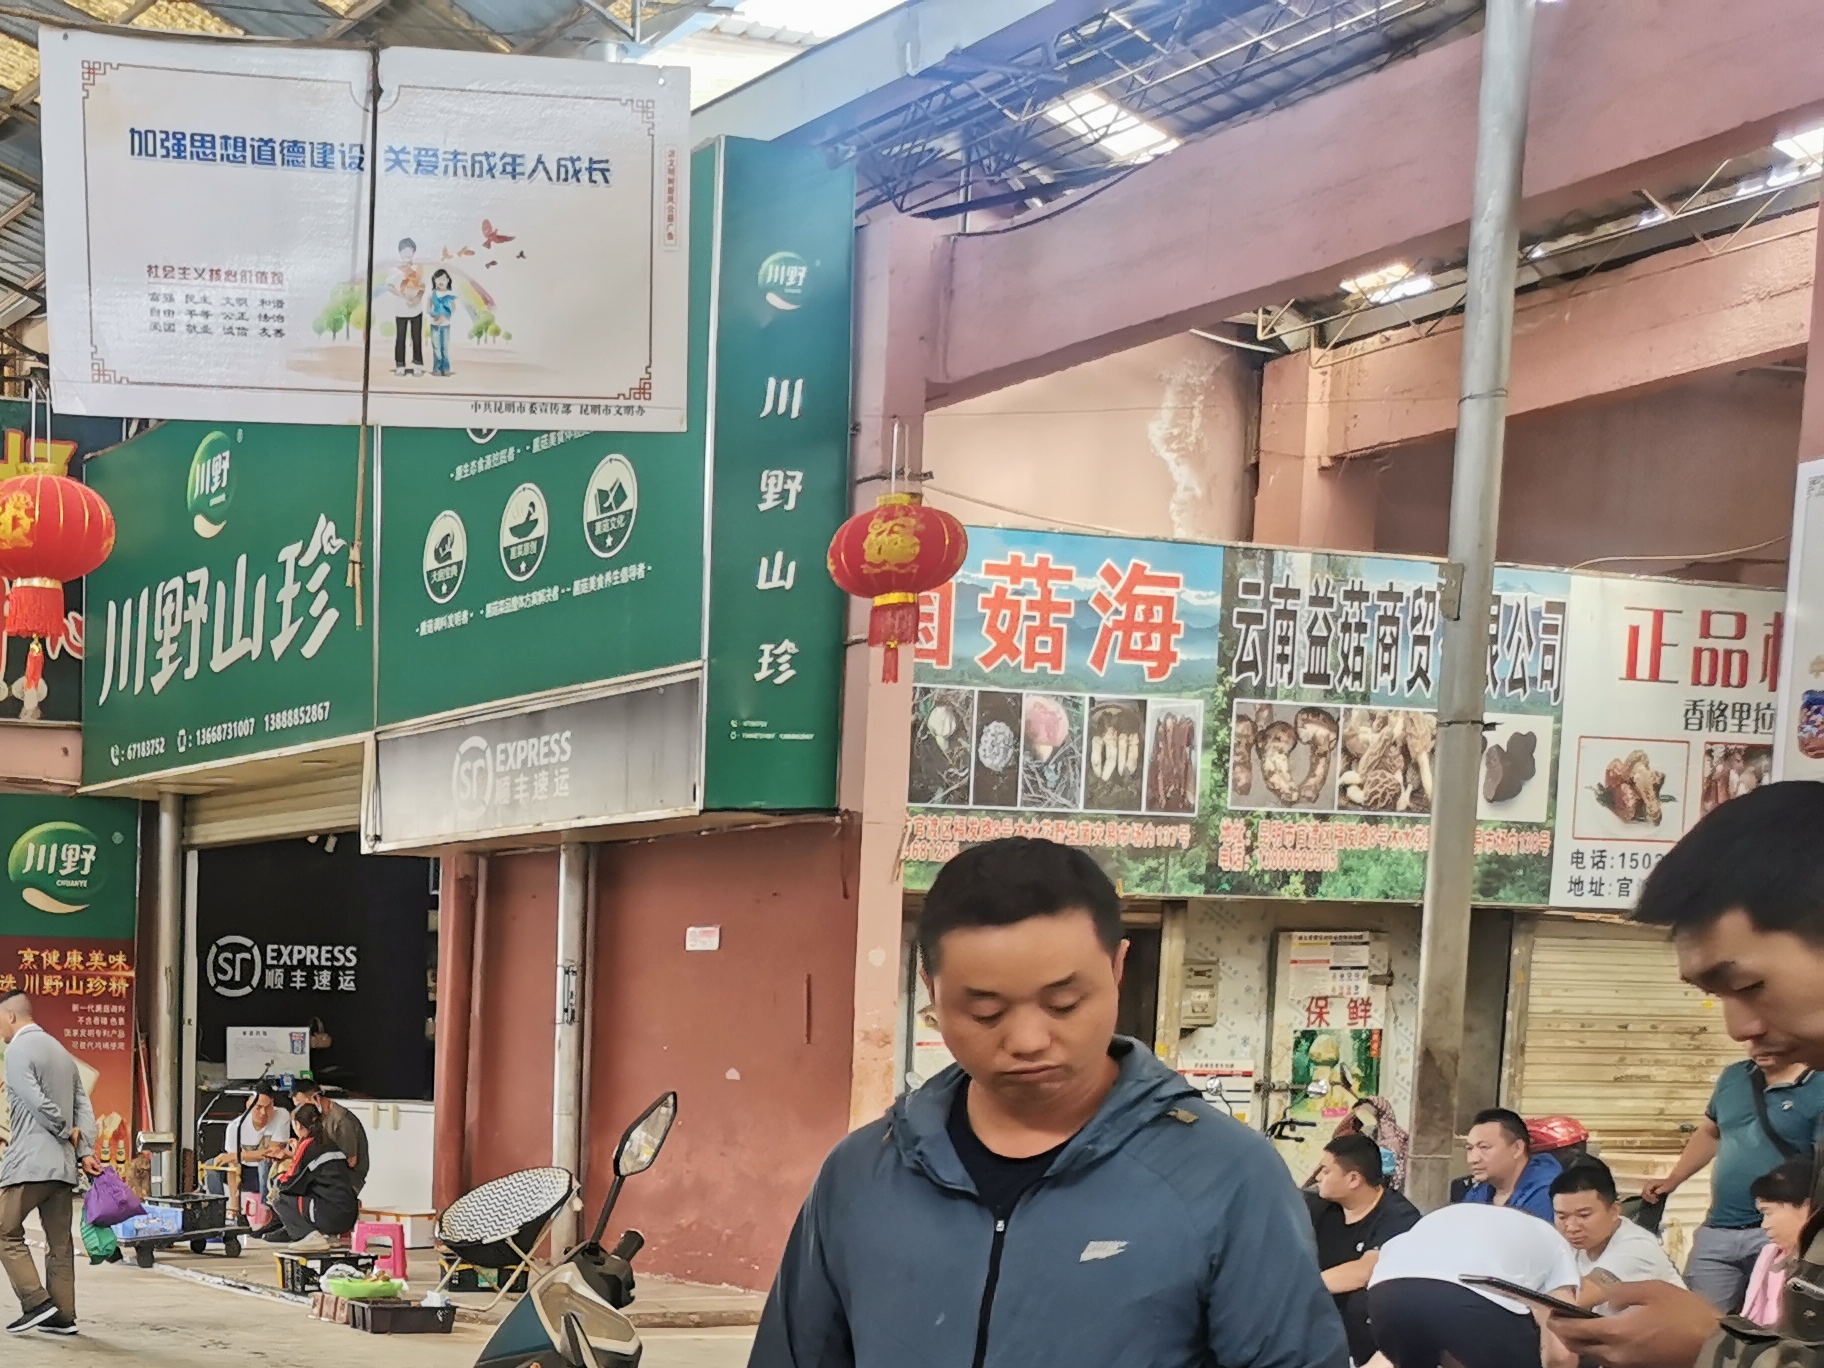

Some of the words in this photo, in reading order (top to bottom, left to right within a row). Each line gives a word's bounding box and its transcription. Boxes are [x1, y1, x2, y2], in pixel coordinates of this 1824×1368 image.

[129, 127, 365, 174] 加强思想道德建设
[384, 144, 612, 187] 关爱未成年人成长
[147, 264, 284, 286] 社会主义核心价值观
[766, 264, 807, 287] 川野
[470, 400, 572, 416] 中共昆明市委宣传部
[579, 402, 646, 417] 昆明市文明办
[193, 450, 230, 500] 川野
[754, 376, 804, 685] 川野山珍
[98, 512, 348, 708] 川野山珍
[1231, 577, 1567, 706] 云南益菇商贸限公司
[195, 717, 256, 747] 13668731007
[264, 700, 331, 732] 13888852867
[1683, 699, 1775, 735] 香格里拉
[127, 736, 166, 761] 67183752
[496, 730, 572, 772] EXPRESS
[494, 767, 571, 805] 顺丰速运
[22, 842, 96, 876] 川野
[1567, 875, 1636, 898] 地址:官
[17, 948, 132, 971] 烹健康美味
[266, 943, 358, 967] EXPRESS
[264, 968, 357, 992] 顺丰速运
[1305, 996, 1373, 1028] 保鲜
